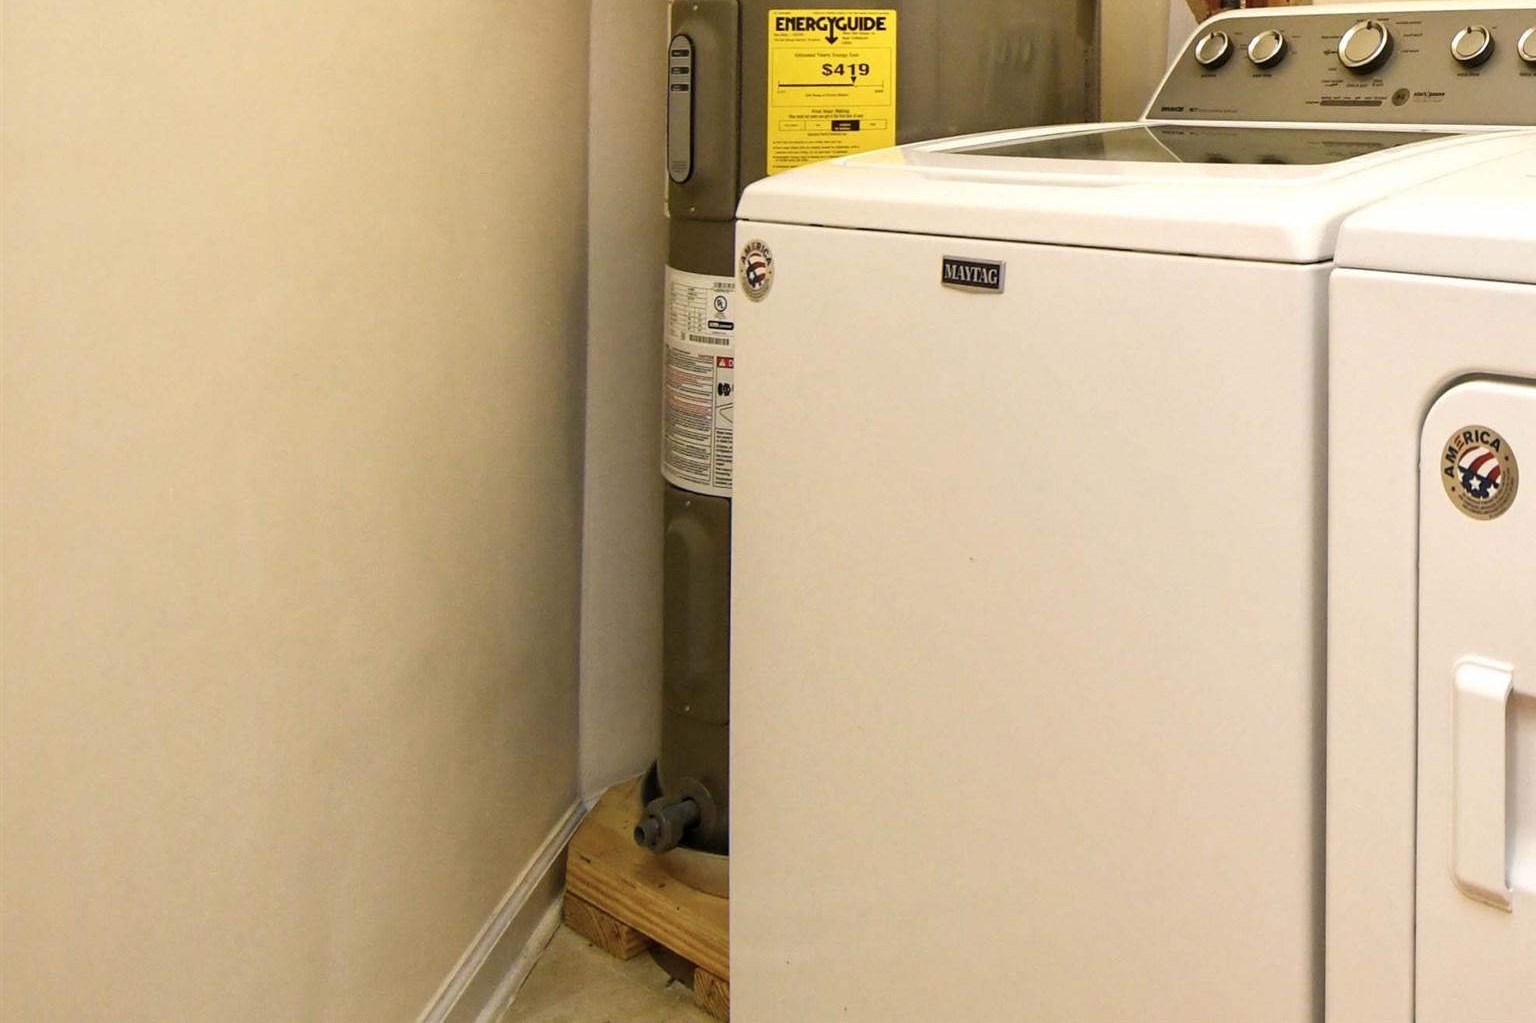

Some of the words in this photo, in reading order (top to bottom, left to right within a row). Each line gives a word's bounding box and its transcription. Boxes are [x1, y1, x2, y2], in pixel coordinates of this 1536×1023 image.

[775, 16, 887, 32] ENERGYGUIDE
[821, 63, 870, 76] $419
[741, 241, 772, 266] AMERICA
[944, 262, 998, 284] MAYTAG
[1443, 429, 1502, 479] AMERICA
